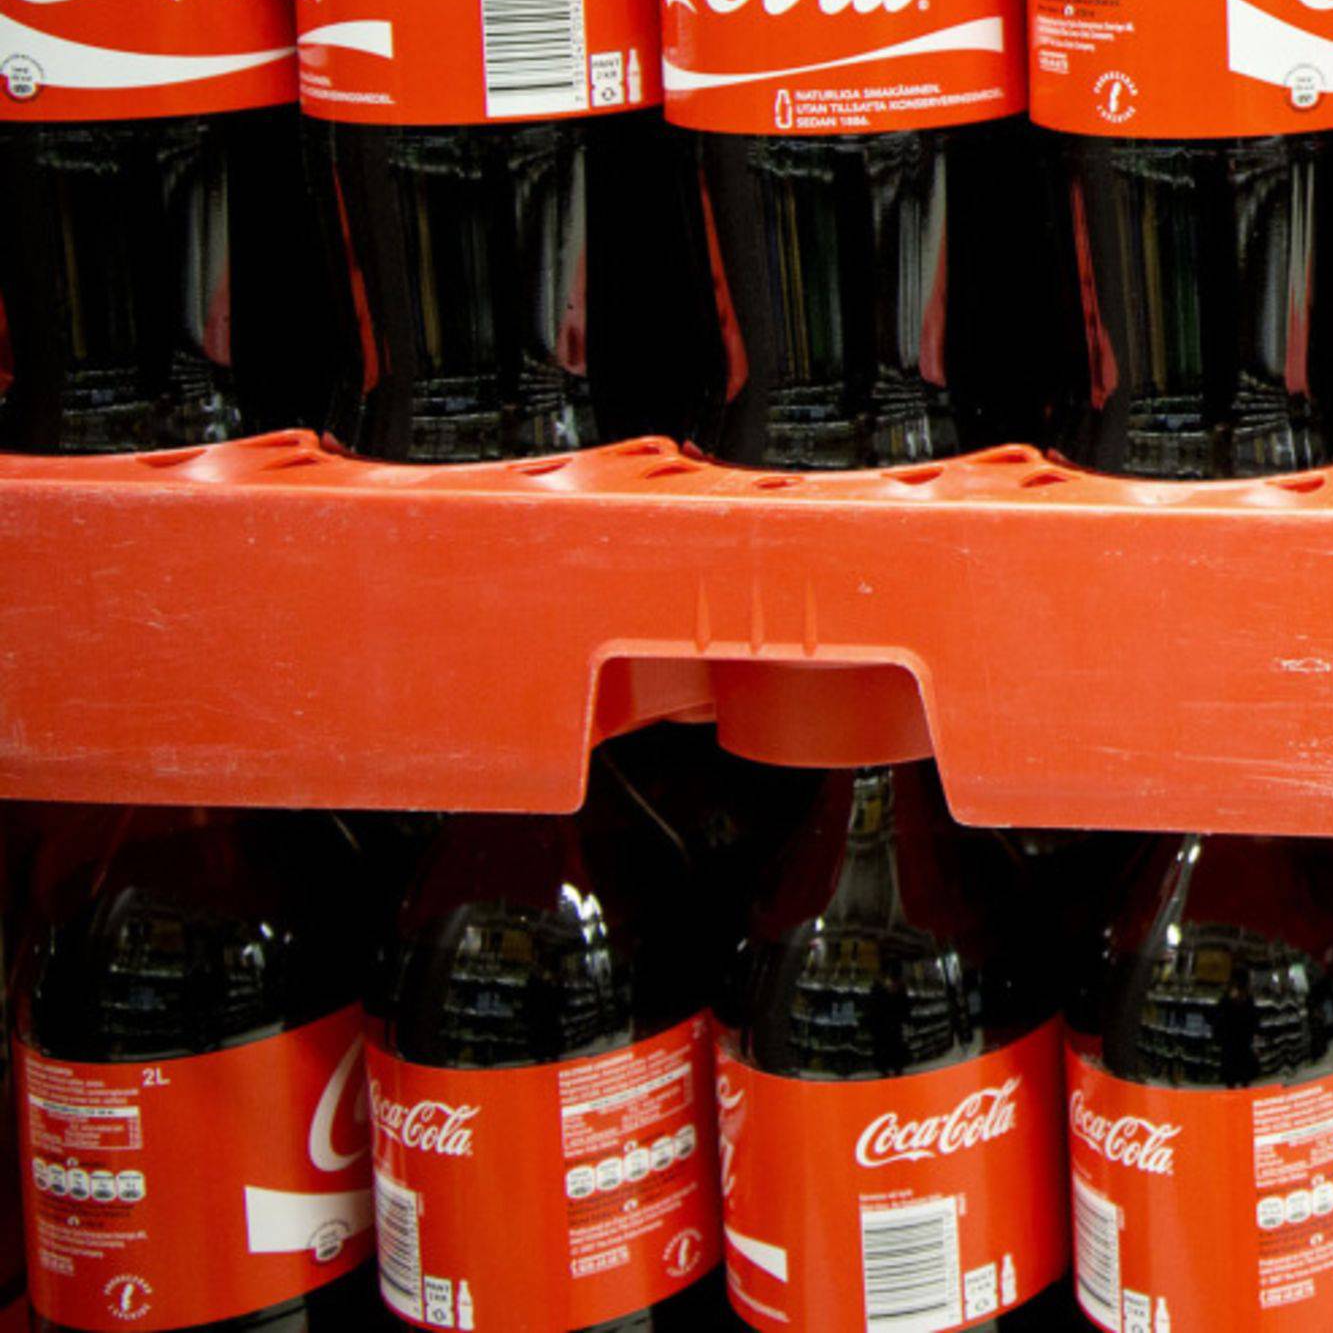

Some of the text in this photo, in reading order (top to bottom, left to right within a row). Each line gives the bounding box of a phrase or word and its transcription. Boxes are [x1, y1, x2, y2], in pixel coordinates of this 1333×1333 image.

[795, 89, 860, 102] NATURLIGA
[796, 102, 828, 115] UTAN
[796, 117, 836, 128] SEDAN
[142, 1068, 171, 1087] 2L
[855, 1074, 1022, 1168] Coca-Cola
